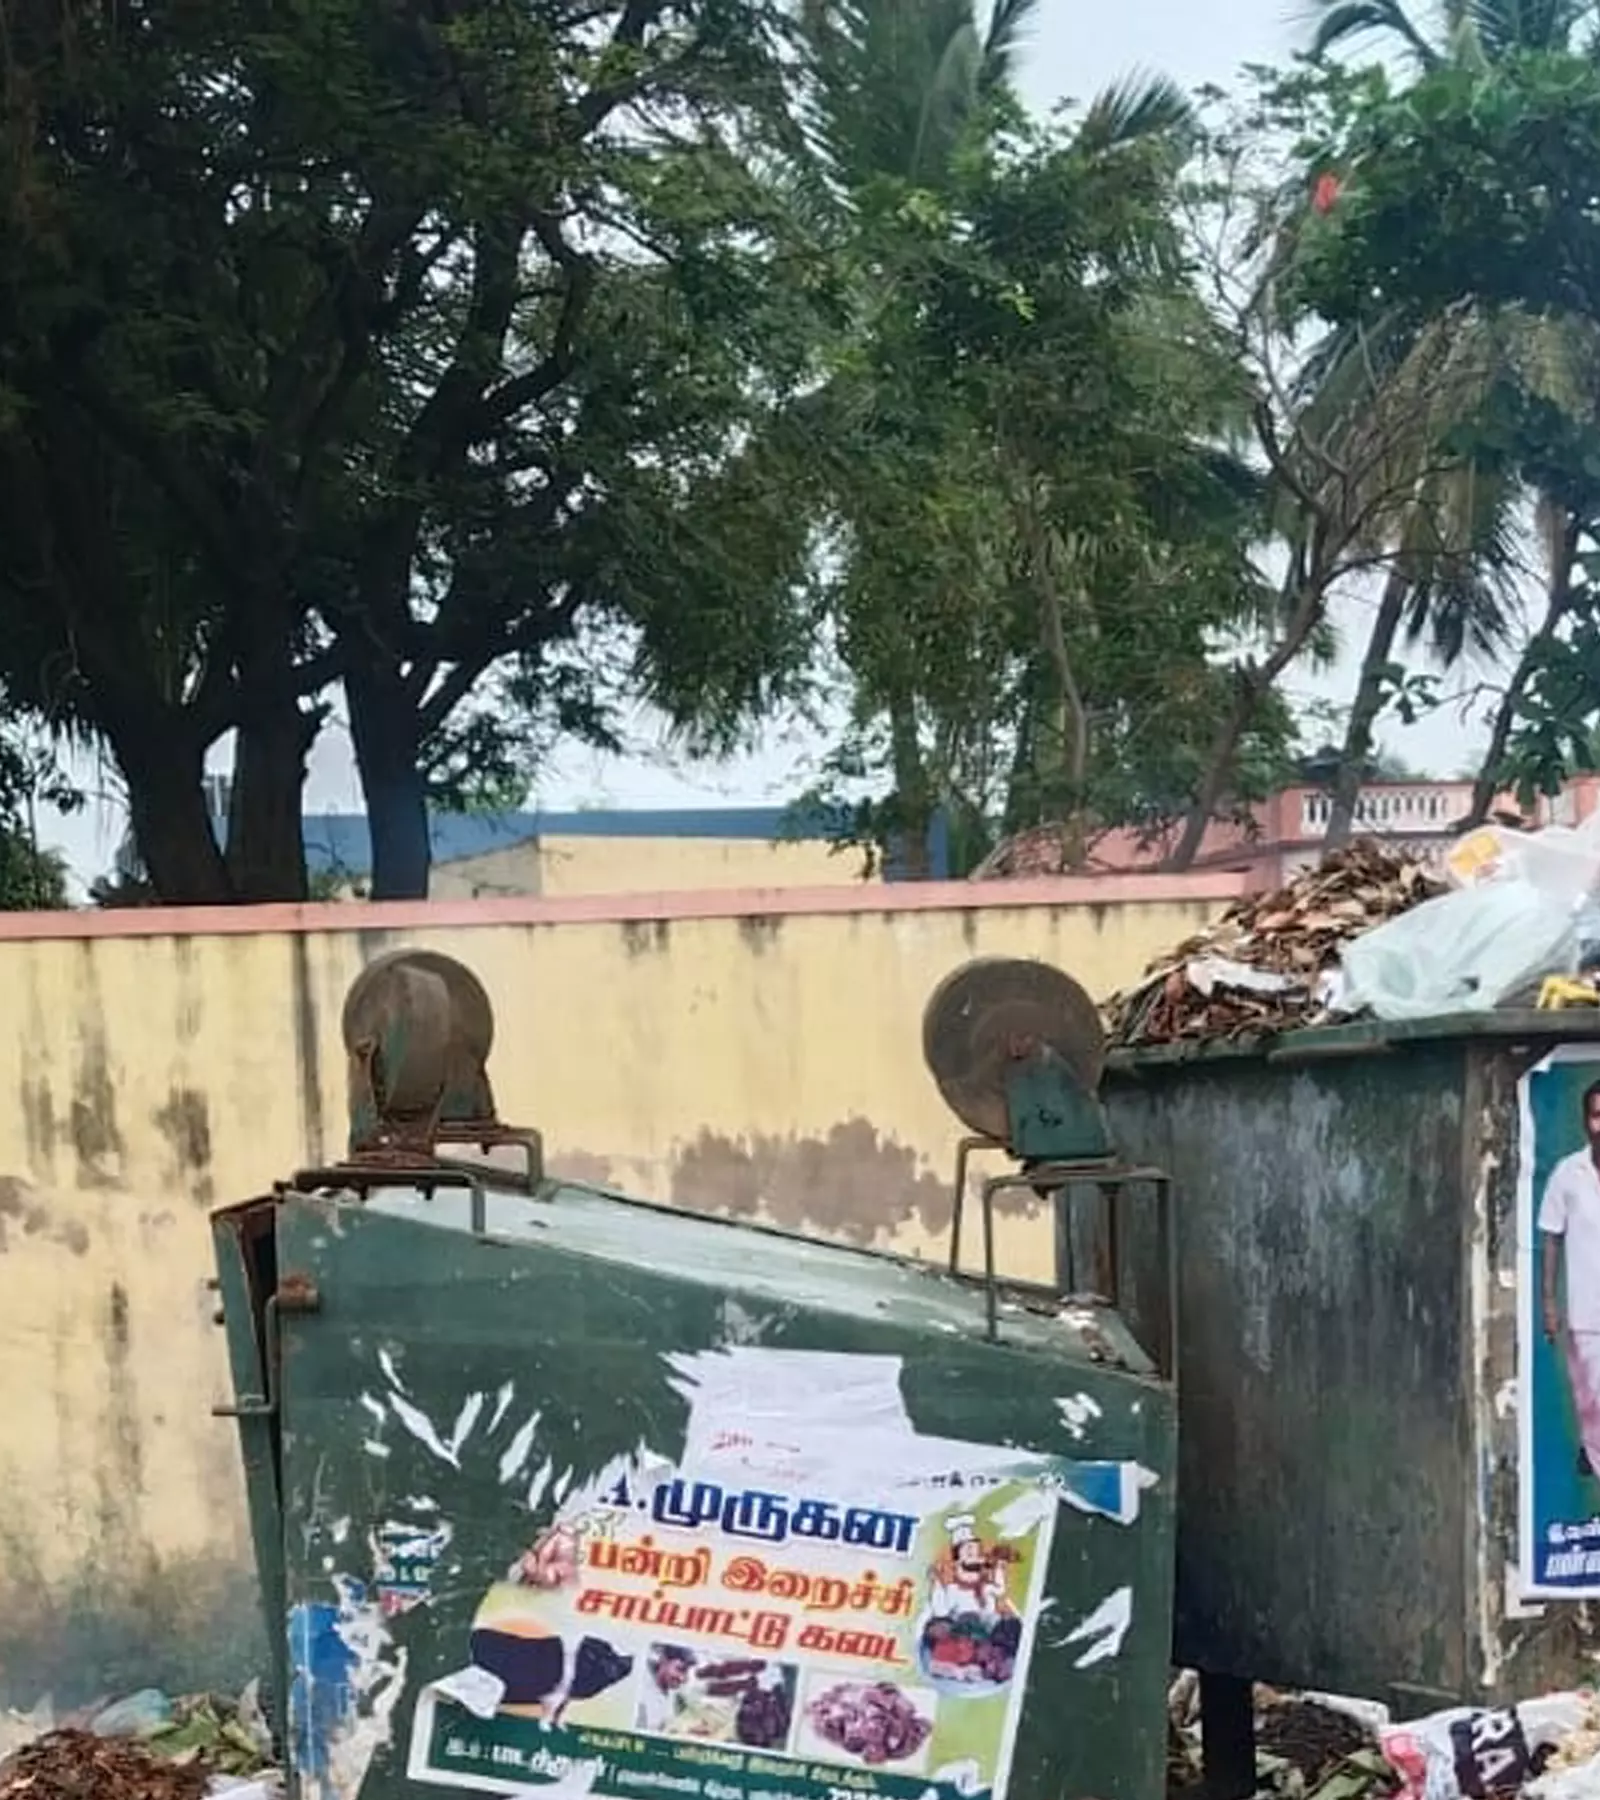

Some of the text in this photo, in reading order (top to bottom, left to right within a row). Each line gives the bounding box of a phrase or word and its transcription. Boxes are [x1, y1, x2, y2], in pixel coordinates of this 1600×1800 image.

[587, 1535, 915, 1617] பன்றி இறைச்சி
[576, 1588, 908, 1663] சாப்பாட்டு கடை
